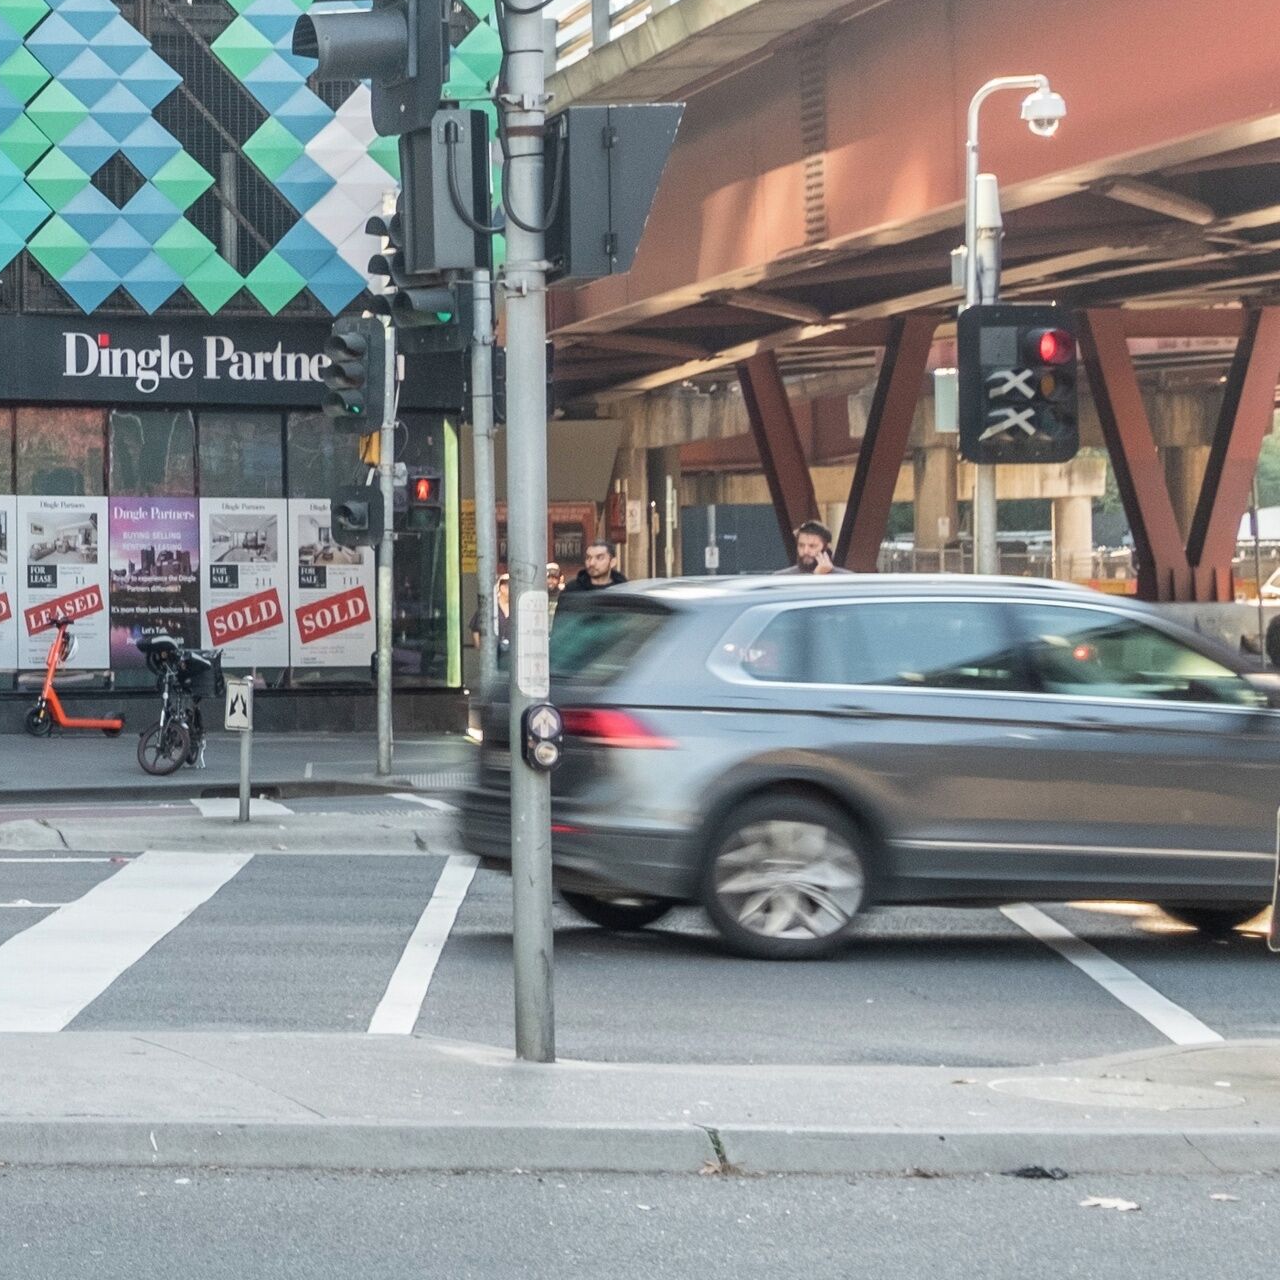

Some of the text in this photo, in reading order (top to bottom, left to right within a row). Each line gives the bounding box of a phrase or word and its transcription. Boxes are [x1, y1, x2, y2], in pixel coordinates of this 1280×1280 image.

[62, 332, 332, 393] Dingle Partne
[113, 506, 195, 521] Dingle Partners
[30, 566, 46, 575] FOR
[212, 567, 227, 575] FOR
[300, 567, 315, 575] FOR
[30, 575, 53, 583] LEASE
[212, 575, 230, 584] SALE
[300, 575, 318, 584] SALE
[28, 592, 99, 630] LEASED
[302, 597, 365, 634] SOLD
[213, 599, 277, 637] SOLD
